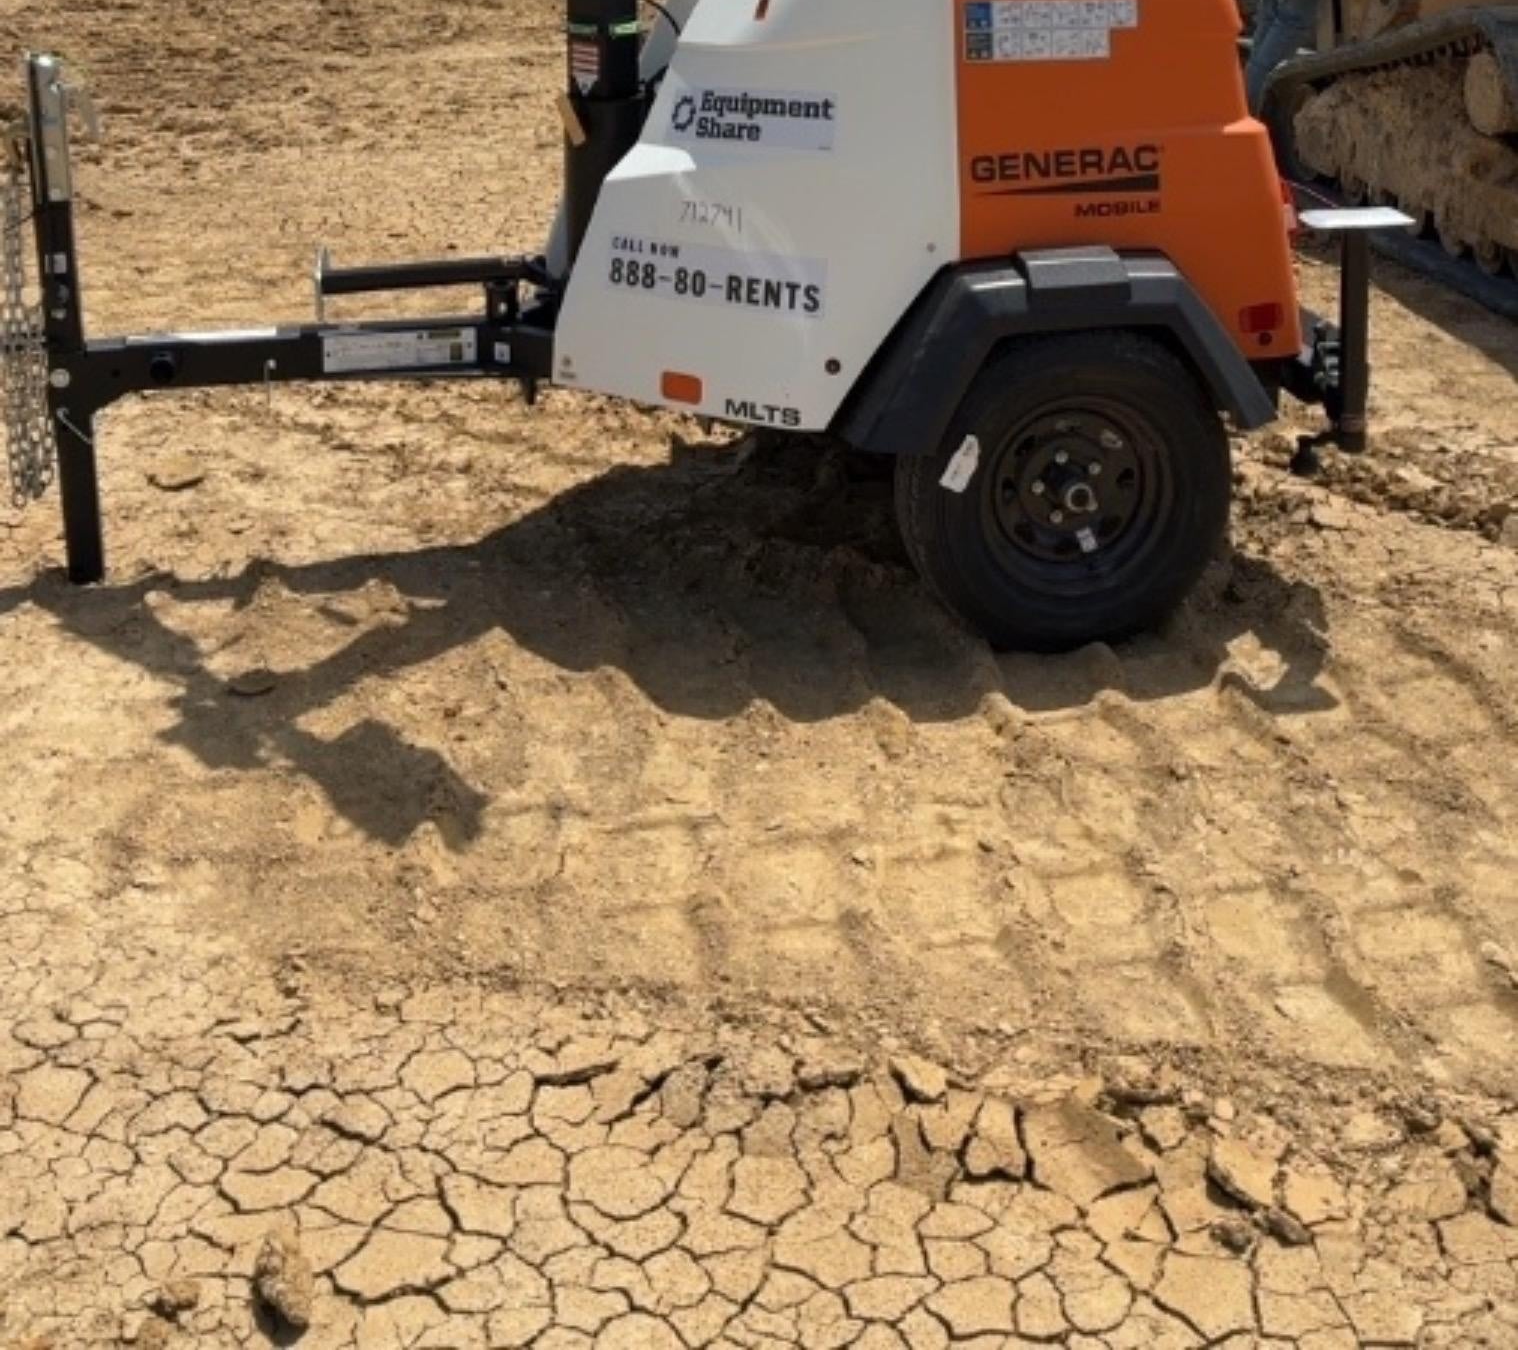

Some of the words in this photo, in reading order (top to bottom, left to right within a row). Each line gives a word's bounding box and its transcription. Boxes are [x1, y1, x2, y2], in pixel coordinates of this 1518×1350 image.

[699, 90, 835, 120] Equipment
[696, 116, 761, 141] Share
[970, 144, 1160, 183] GENERAC
[680, 200, 742, 232] 712741
[1073, 200, 1162, 218] MOBILE
[611, 236, 643, 253] CALL
[650, 241, 680, 258] NOW
[609, 256, 821, 313] 888-80-RENTS
[725, 398, 801, 427] MLTS
